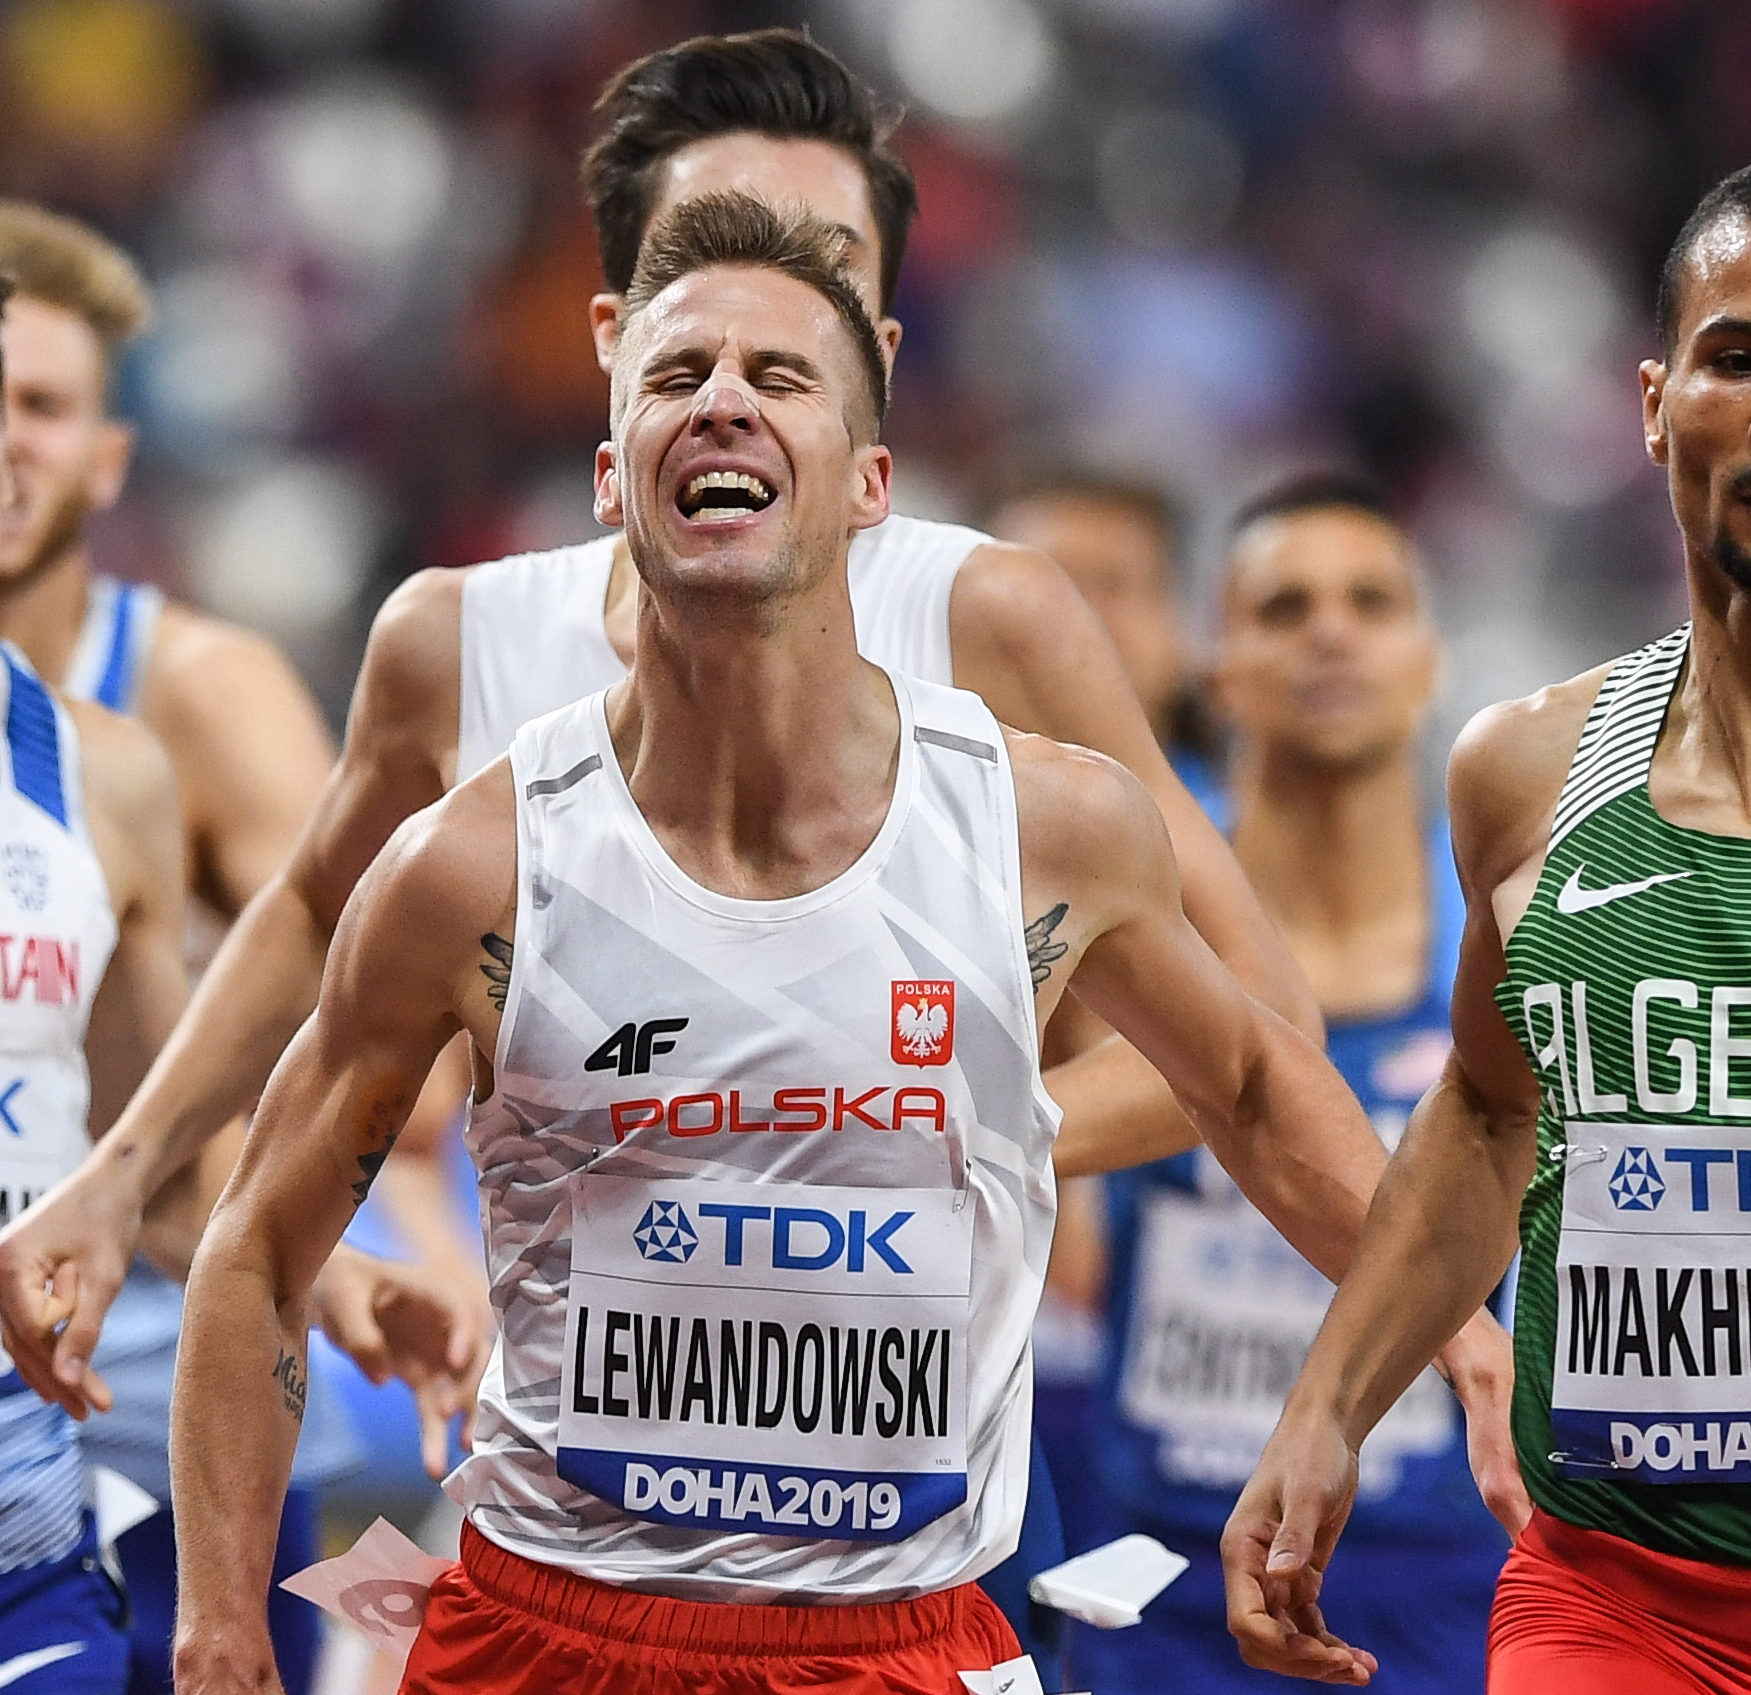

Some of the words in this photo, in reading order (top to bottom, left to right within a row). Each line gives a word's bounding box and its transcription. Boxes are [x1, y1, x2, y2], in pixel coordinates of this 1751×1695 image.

[896, 983, 951, 996] POLSKA
[610, 1085, 946, 1144] POLSKA
[699, 1203, 916, 1275] TDK
[571, 1305, 951, 1440] LEWANDOWSKI
[623, 1462, 902, 1532] DOHA2019
